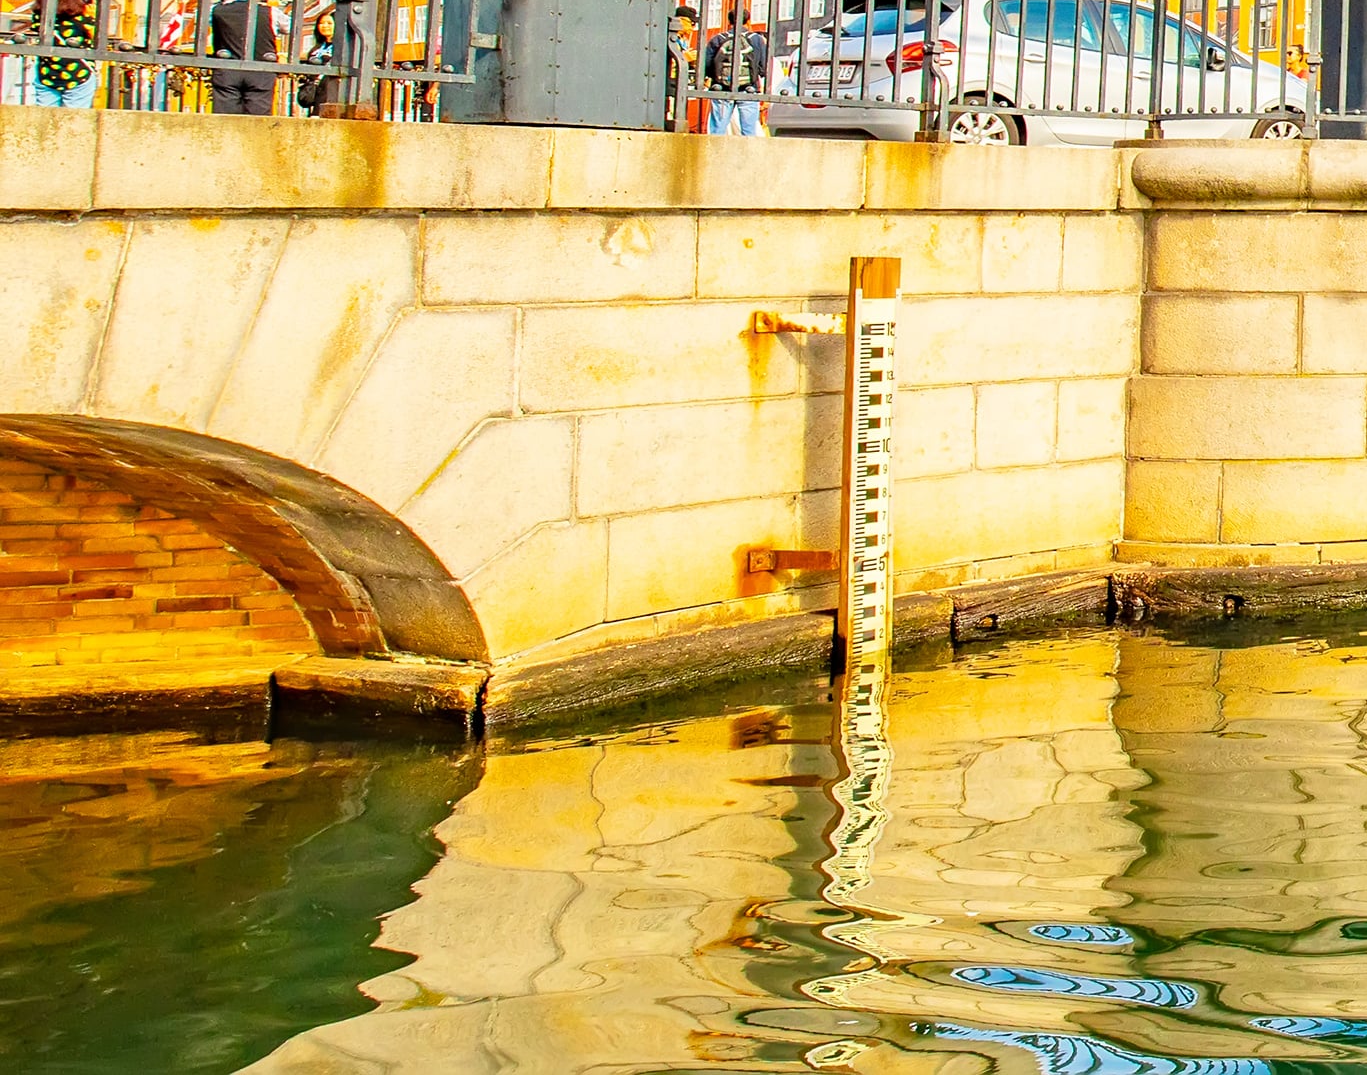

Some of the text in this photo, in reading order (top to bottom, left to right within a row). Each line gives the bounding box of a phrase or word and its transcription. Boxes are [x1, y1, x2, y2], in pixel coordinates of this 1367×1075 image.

[887, 371, 894, 380] 13
[886, 394, 892, 403] 12
[885, 418, 891, 427] 11
[883, 464, 888, 474] 9
[882, 487, 887, 497] 8
[882, 510, 886, 520] 7
[881, 534, 886, 544] 6
[879, 554, 887, 571] 5
[880, 605, 885, 615] 3
[879, 628, 884, 638] 2
